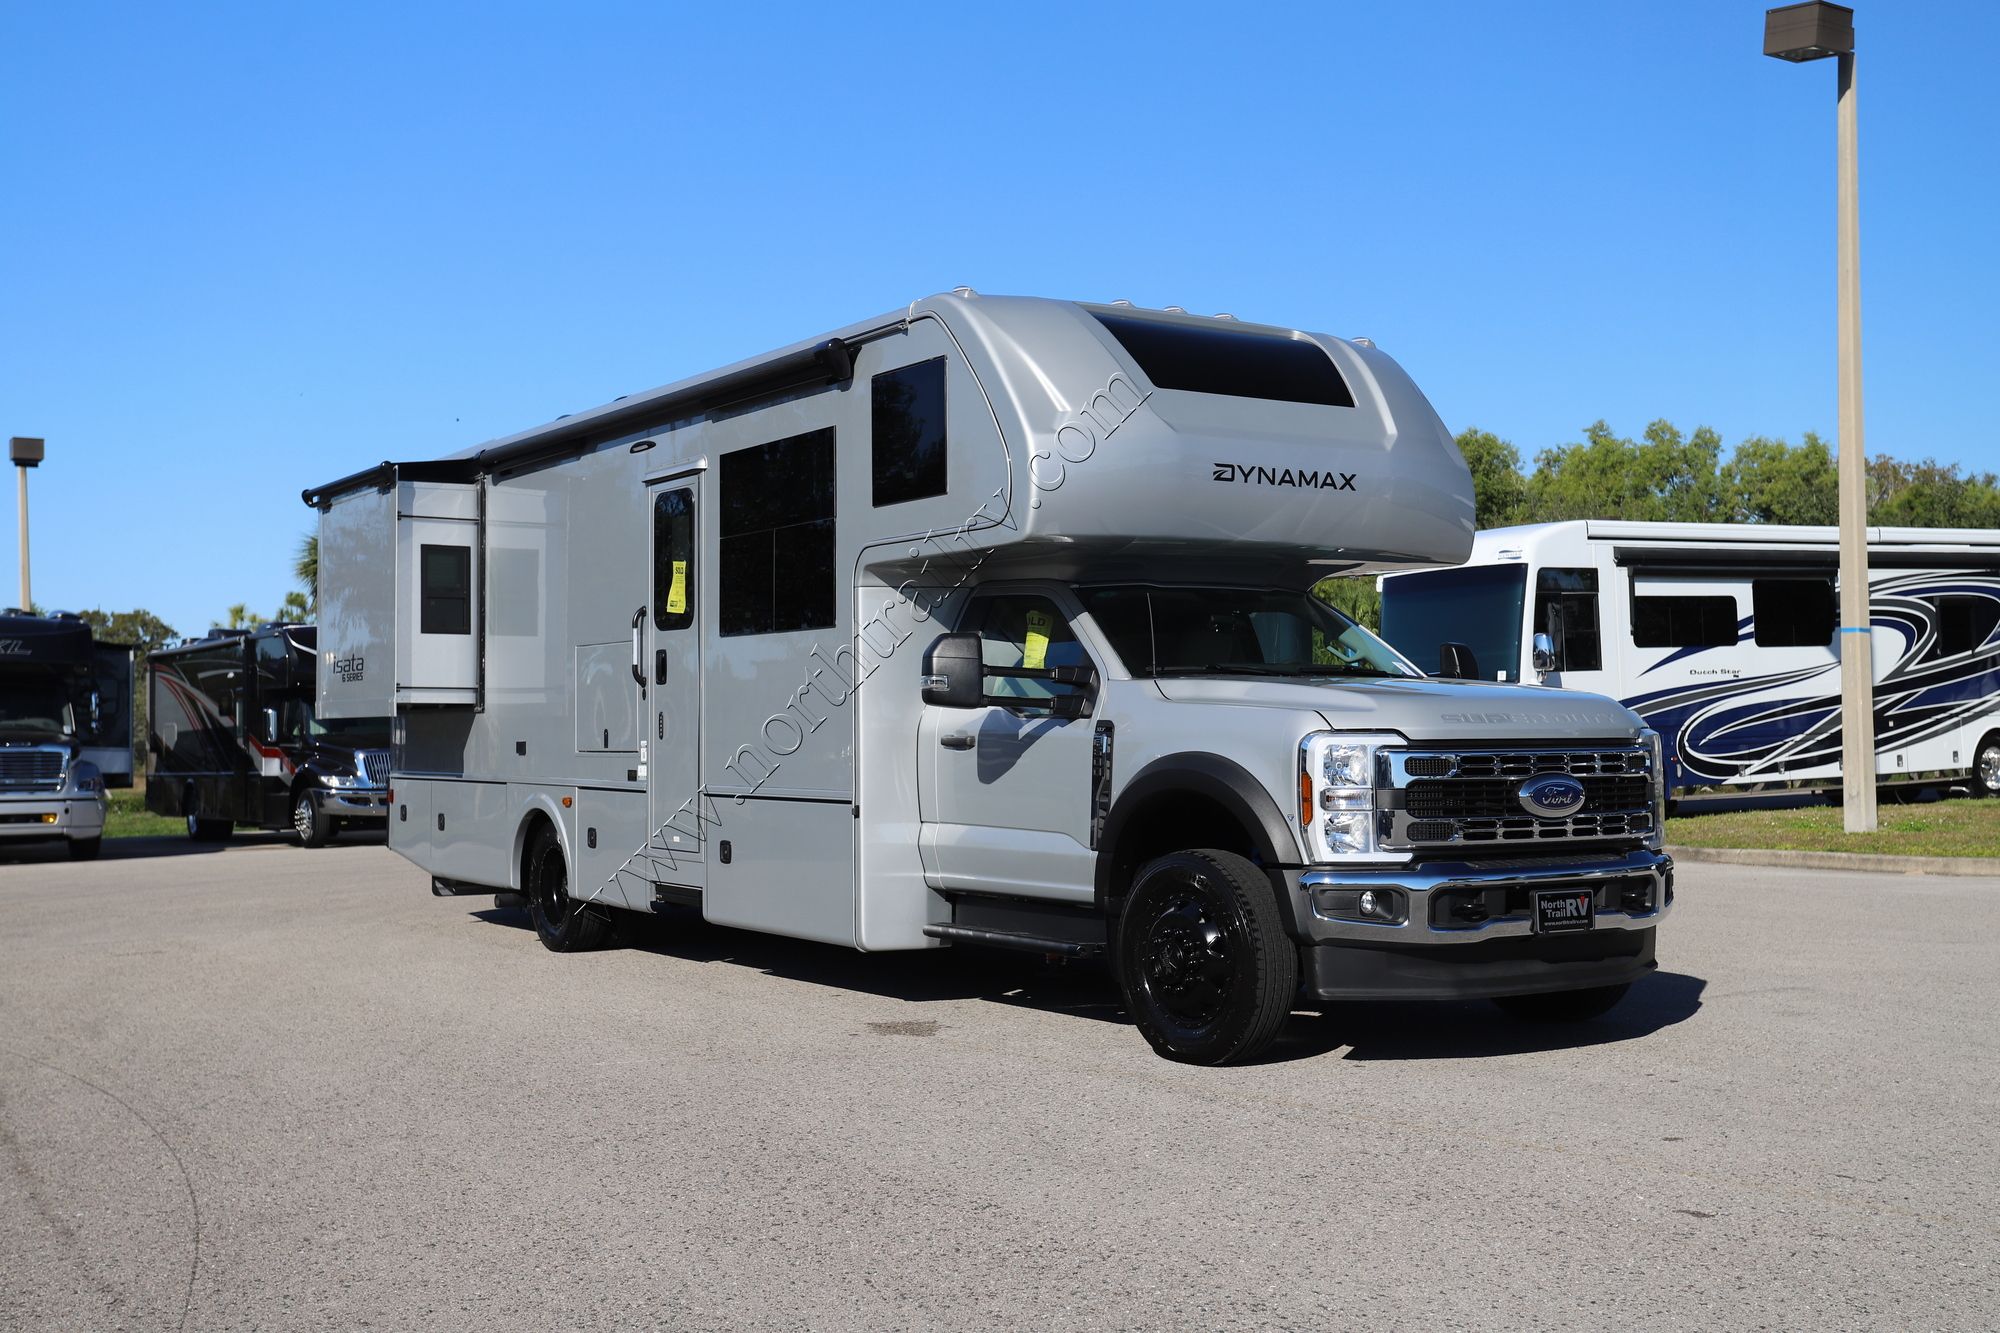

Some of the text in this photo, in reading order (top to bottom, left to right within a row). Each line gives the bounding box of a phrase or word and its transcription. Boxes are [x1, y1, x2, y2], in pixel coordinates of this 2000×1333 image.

[1212, 462, 1357, 492] DYNAMAX
[332, 652, 365, 674] isata
[346, 671, 364, 682] SERIES
[1542, 786, 1573, 805] Ford
[1541, 899, 1566, 909] North
[1546, 908, 1566, 918] Trail
[1566, 896, 1589, 917] RV
